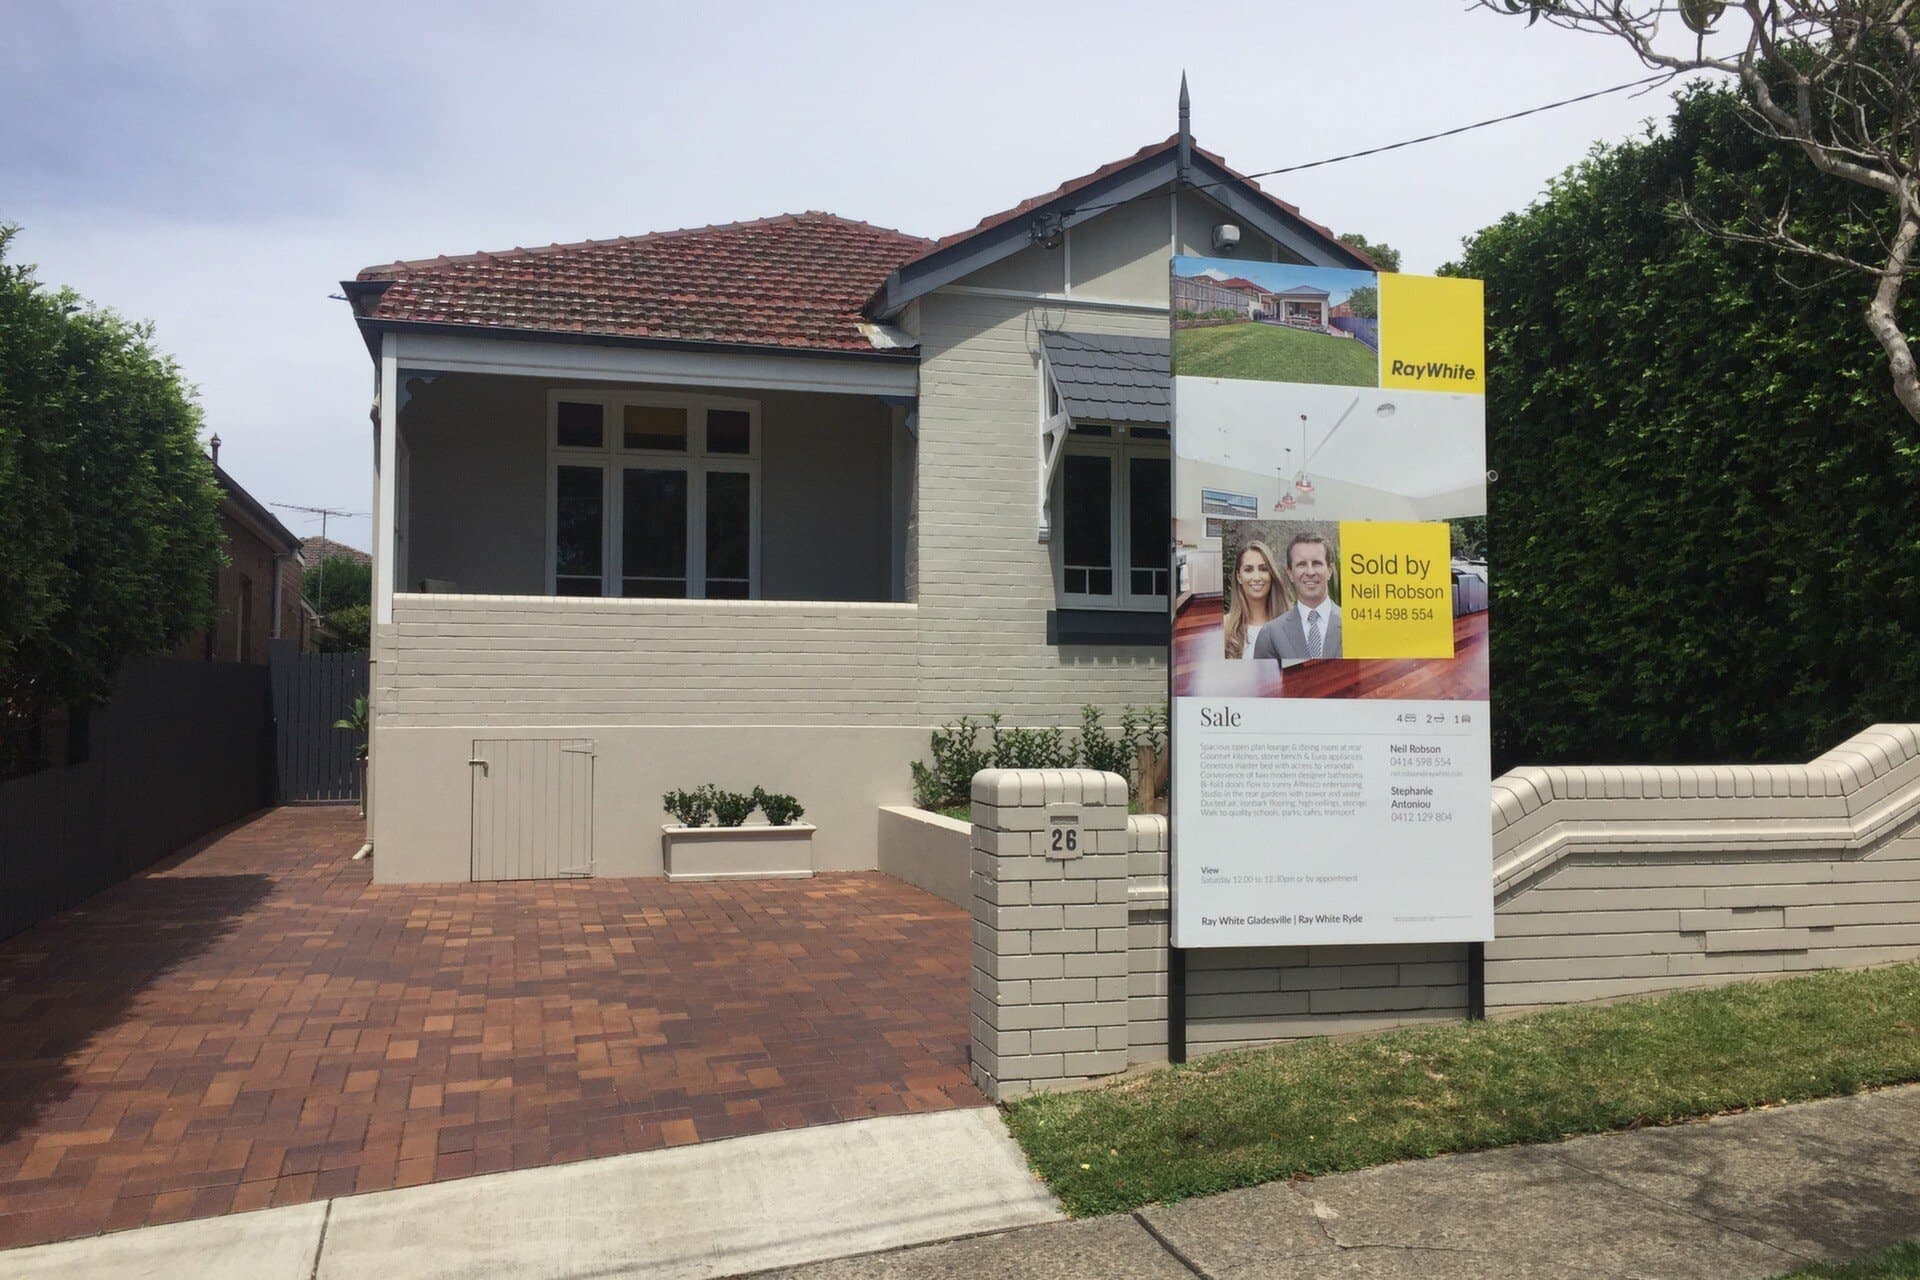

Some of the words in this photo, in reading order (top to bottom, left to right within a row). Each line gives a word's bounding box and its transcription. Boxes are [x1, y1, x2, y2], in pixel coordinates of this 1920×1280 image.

[1351, 553, 1397, 575] Sold
[1406, 554, 1430, 580] by
[1351, 584, 1380, 599] Neil
[1385, 584, 1444, 599] Robson
[1351, 608, 1381, 620] 0414
[1385, 608, 1408, 620] 598
[1412, 608, 1433, 620] 554
[1200, 706, 1241, 727] Sale
[1396, 714, 1403, 722] 4
[1426, 714, 1433, 723] 2
[1455, 715, 1459, 723] 1
[1390, 744, 1407, 753] Neil
[1409, 744, 1441, 753] Robson
[1390, 757, 1412, 767] 0414
[1415, 757, 1432, 767] 598
[1435, 757, 1451, 767] 554
[1391, 786, 1433, 797] Stephanie
[1391, 800, 1431, 809] Antoniou
[1391, 812, 1414, 822] 0412
[1417, 812, 1433, 822] 129
[1435, 812, 1452, 822] 804
[1052, 829, 1077, 851] 26
[1200, 866, 1219, 874] View
[1200, 875, 1231, 885] Saturday
[1255, 876, 1263, 884] to
[1306, 875, 1314, 884] by
[1316, 875, 1358, 884] appointment
[1202, 916, 1217, 927] Ray
[1219, 916, 1245, 925] White
[1247, 915, 1292, 925] Gladesville
[1299, 915, 1313, 925] Ray
[1315, 914, 1341, 924] White
[1343, 914, 1363, 925] Ryde
